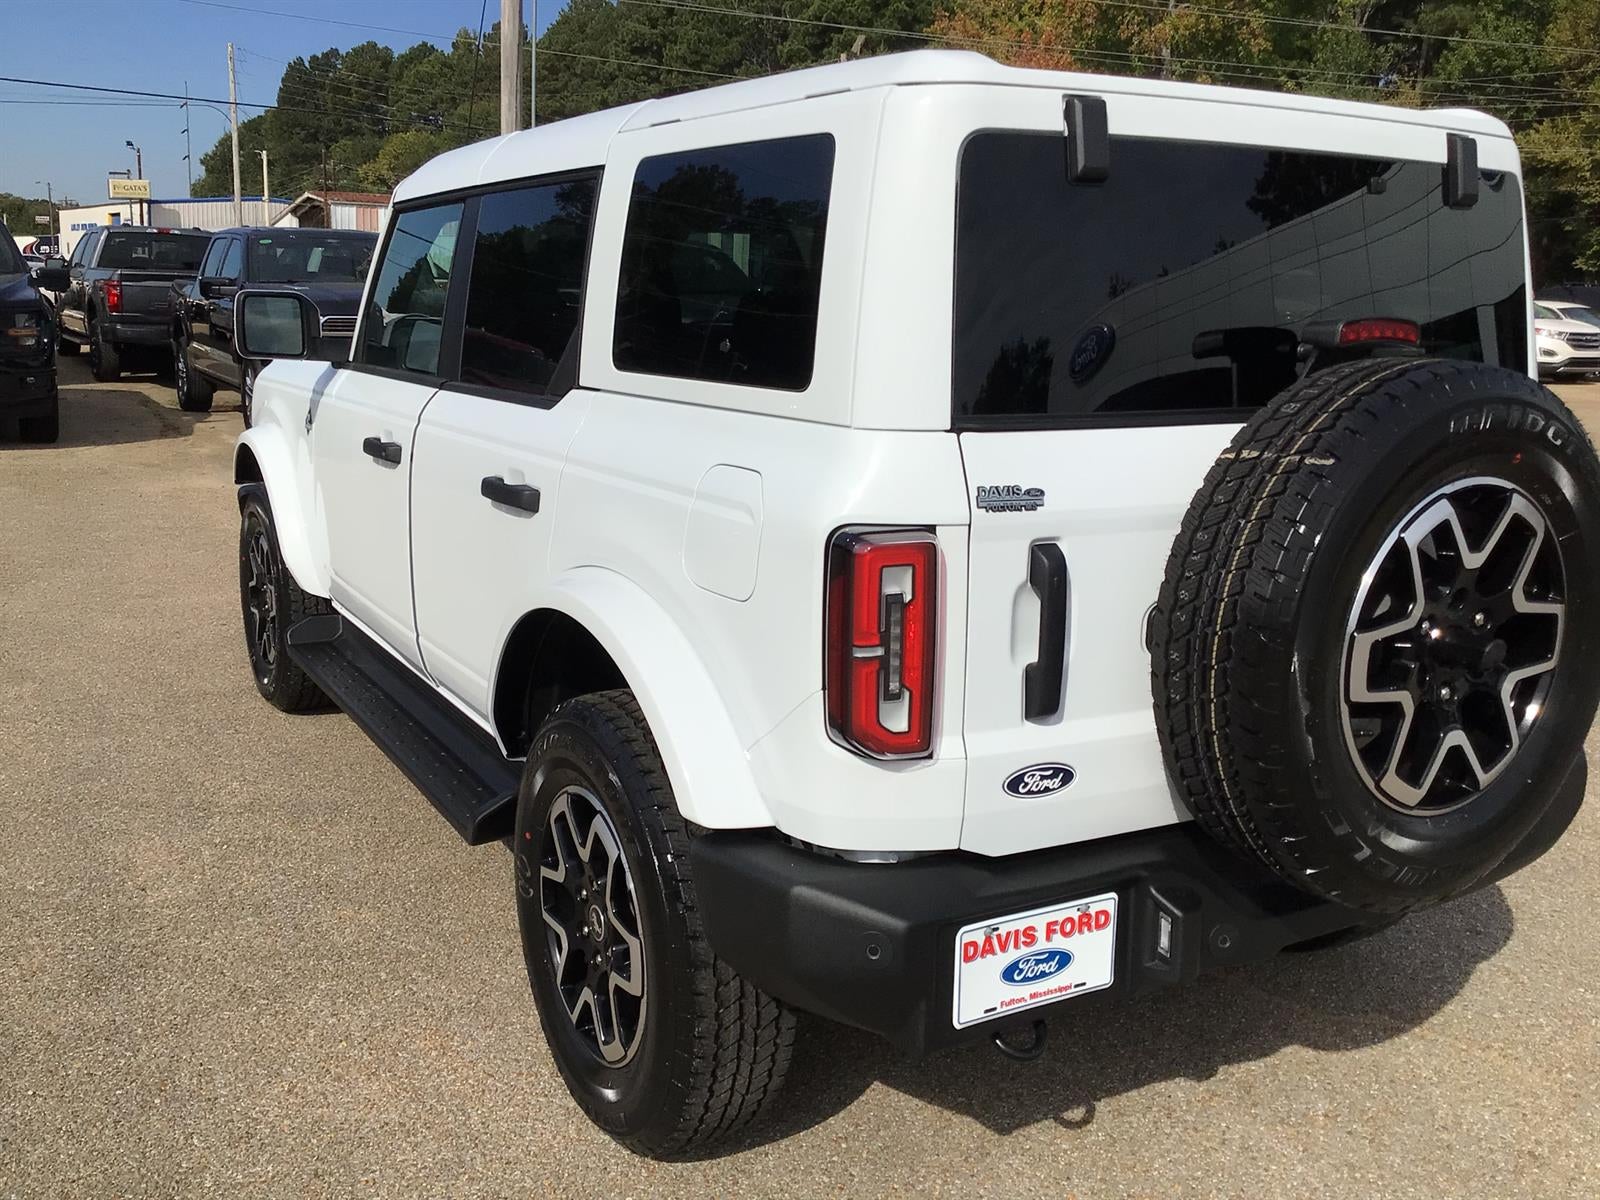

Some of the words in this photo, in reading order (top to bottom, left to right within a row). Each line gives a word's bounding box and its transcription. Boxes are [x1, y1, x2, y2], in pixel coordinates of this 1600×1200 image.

[977, 485, 1022, 499] DAVIS
[985, 501, 1022, 513] FULTON
[1018, 769, 1064, 793] Ford
[962, 925, 1038, 965] DAVIS
[1045, 908, 1112, 943] FORD
[1013, 953, 1059, 981] Ford
[1000, 996, 1027, 1010] Fulton,
[1028, 982, 1073, 1001] Mississippi
